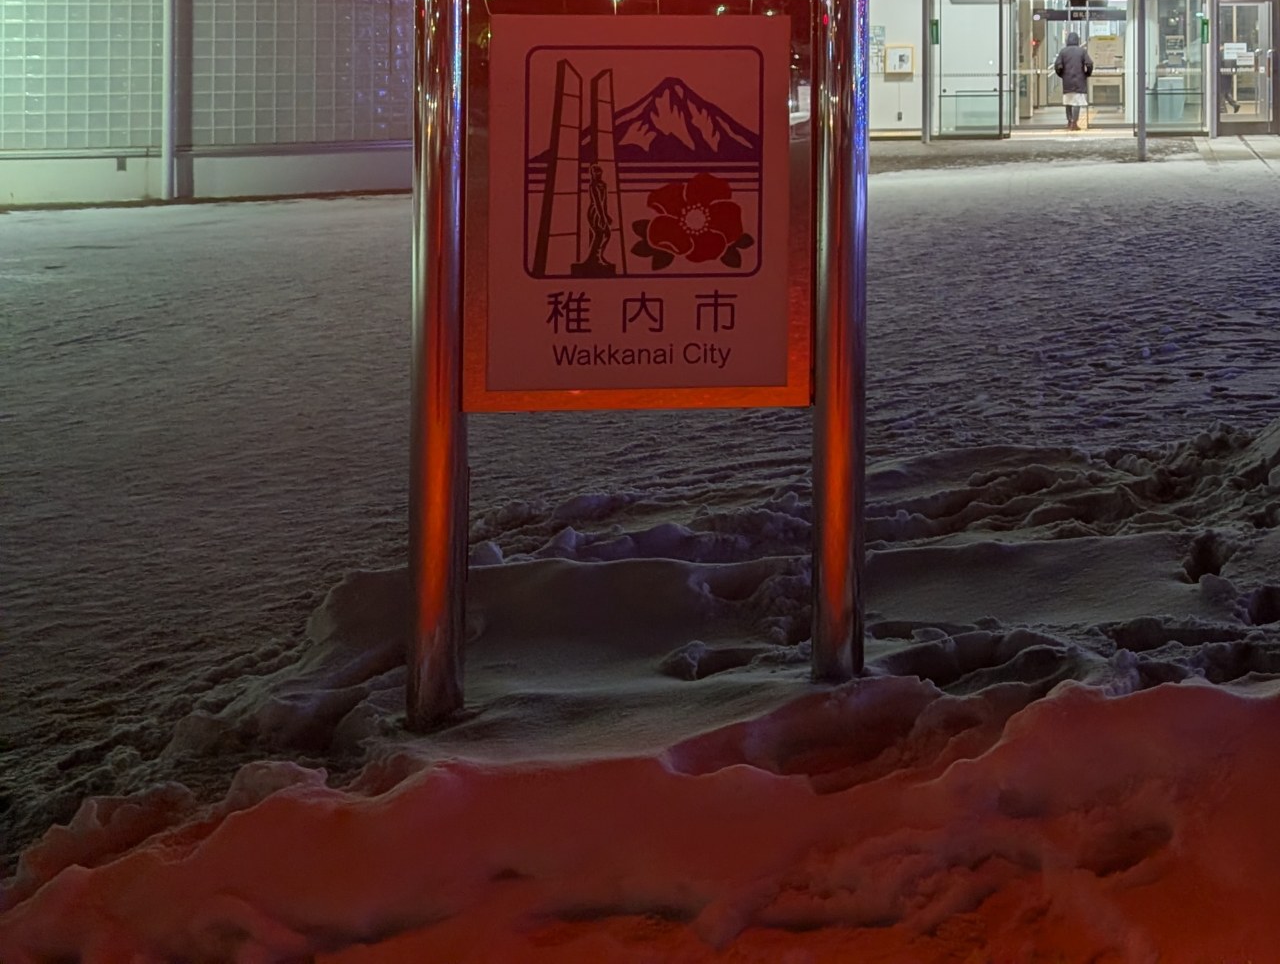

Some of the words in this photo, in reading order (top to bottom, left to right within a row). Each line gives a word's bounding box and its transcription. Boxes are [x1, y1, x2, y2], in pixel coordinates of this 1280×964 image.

[546, 289, 738, 335] 稚内市
[552, 342, 674, 367] Wakkanai
[682, 341, 732, 369] City
